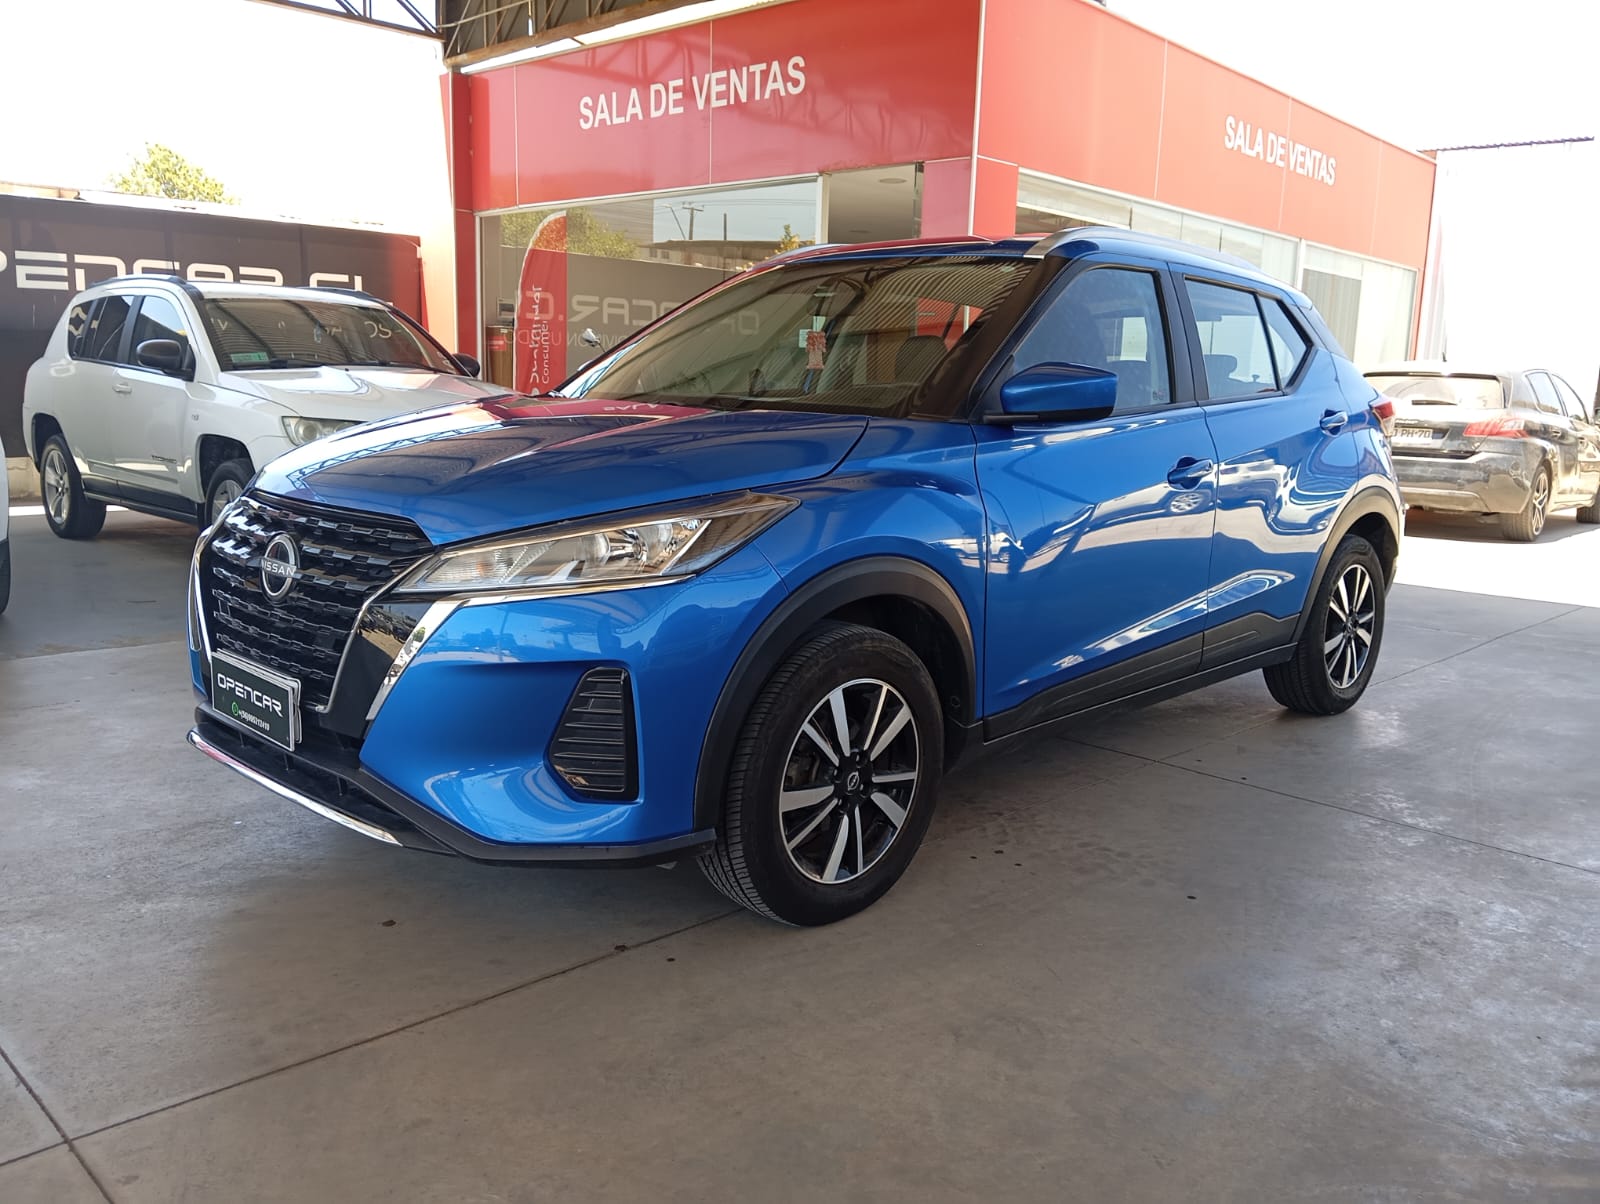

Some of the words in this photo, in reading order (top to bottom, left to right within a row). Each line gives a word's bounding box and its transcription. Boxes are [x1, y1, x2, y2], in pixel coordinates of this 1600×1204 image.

[579, 88, 643, 130] SALA
[650, 78, 684, 118] DE
[692, 56, 806, 110] VENTAS
[1224, 115, 1264, 161] SALA
[1266, 132, 1287, 168] DE
[1288, 140, 1336, 186] VENTAS
[217, 673, 283, 718] OPENCAR
